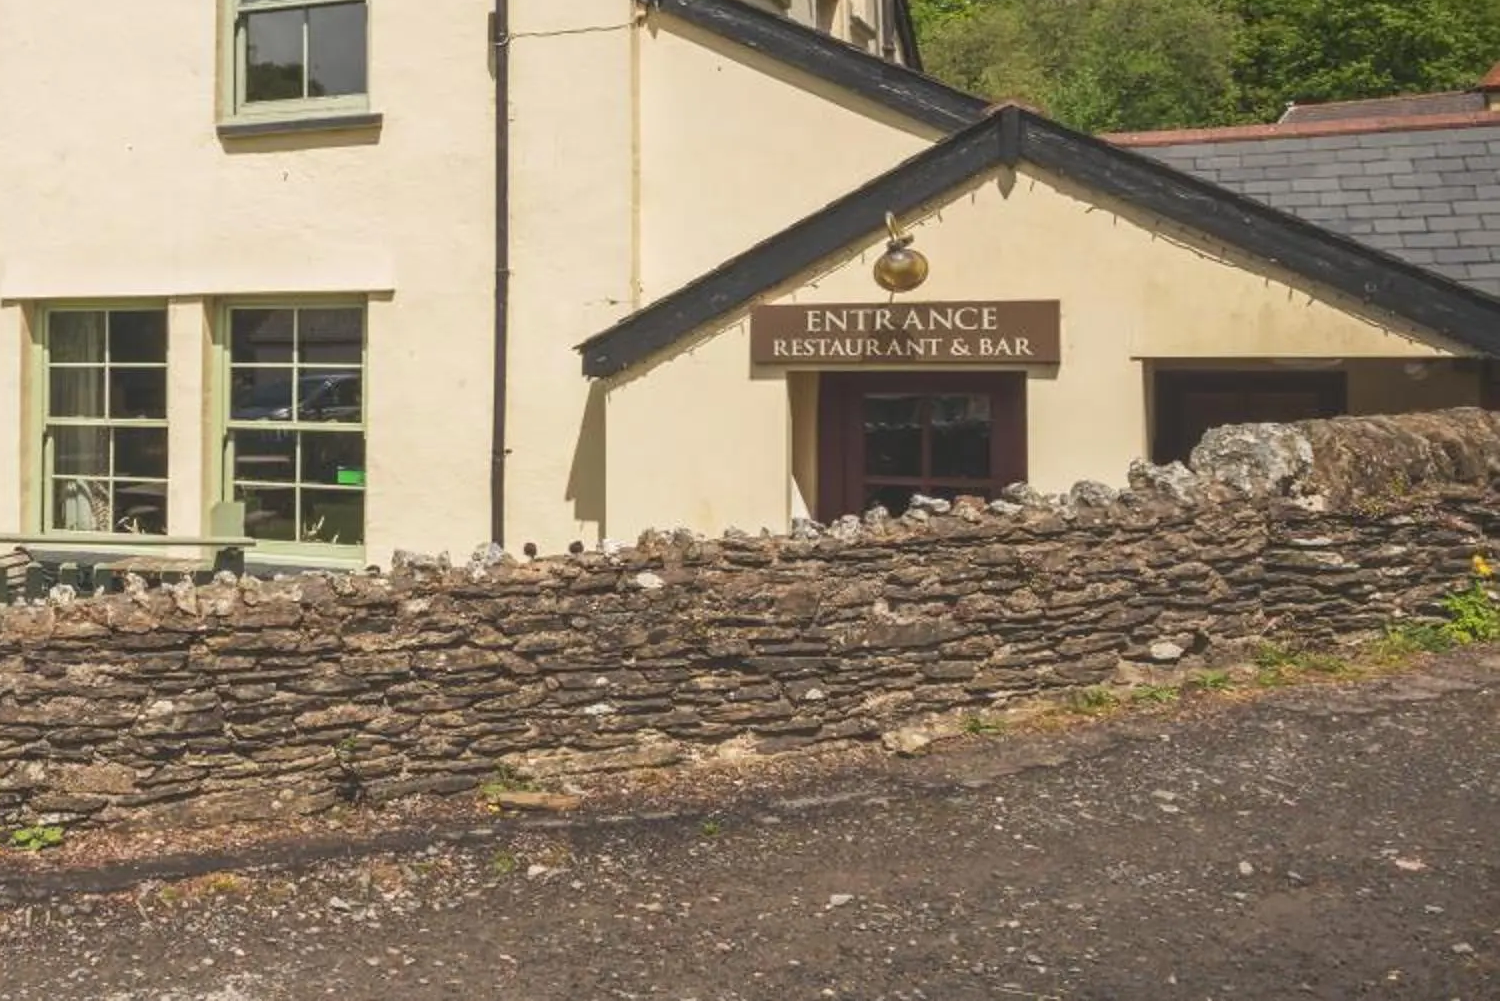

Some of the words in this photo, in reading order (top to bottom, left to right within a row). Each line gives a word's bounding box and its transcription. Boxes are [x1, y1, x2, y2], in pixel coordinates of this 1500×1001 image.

[804, 307, 997, 332] ENTRANCE
[773, 338, 943, 356] RESTAURANT
[950, 338, 972, 356] &
[979, 337, 1034, 356] BAR
